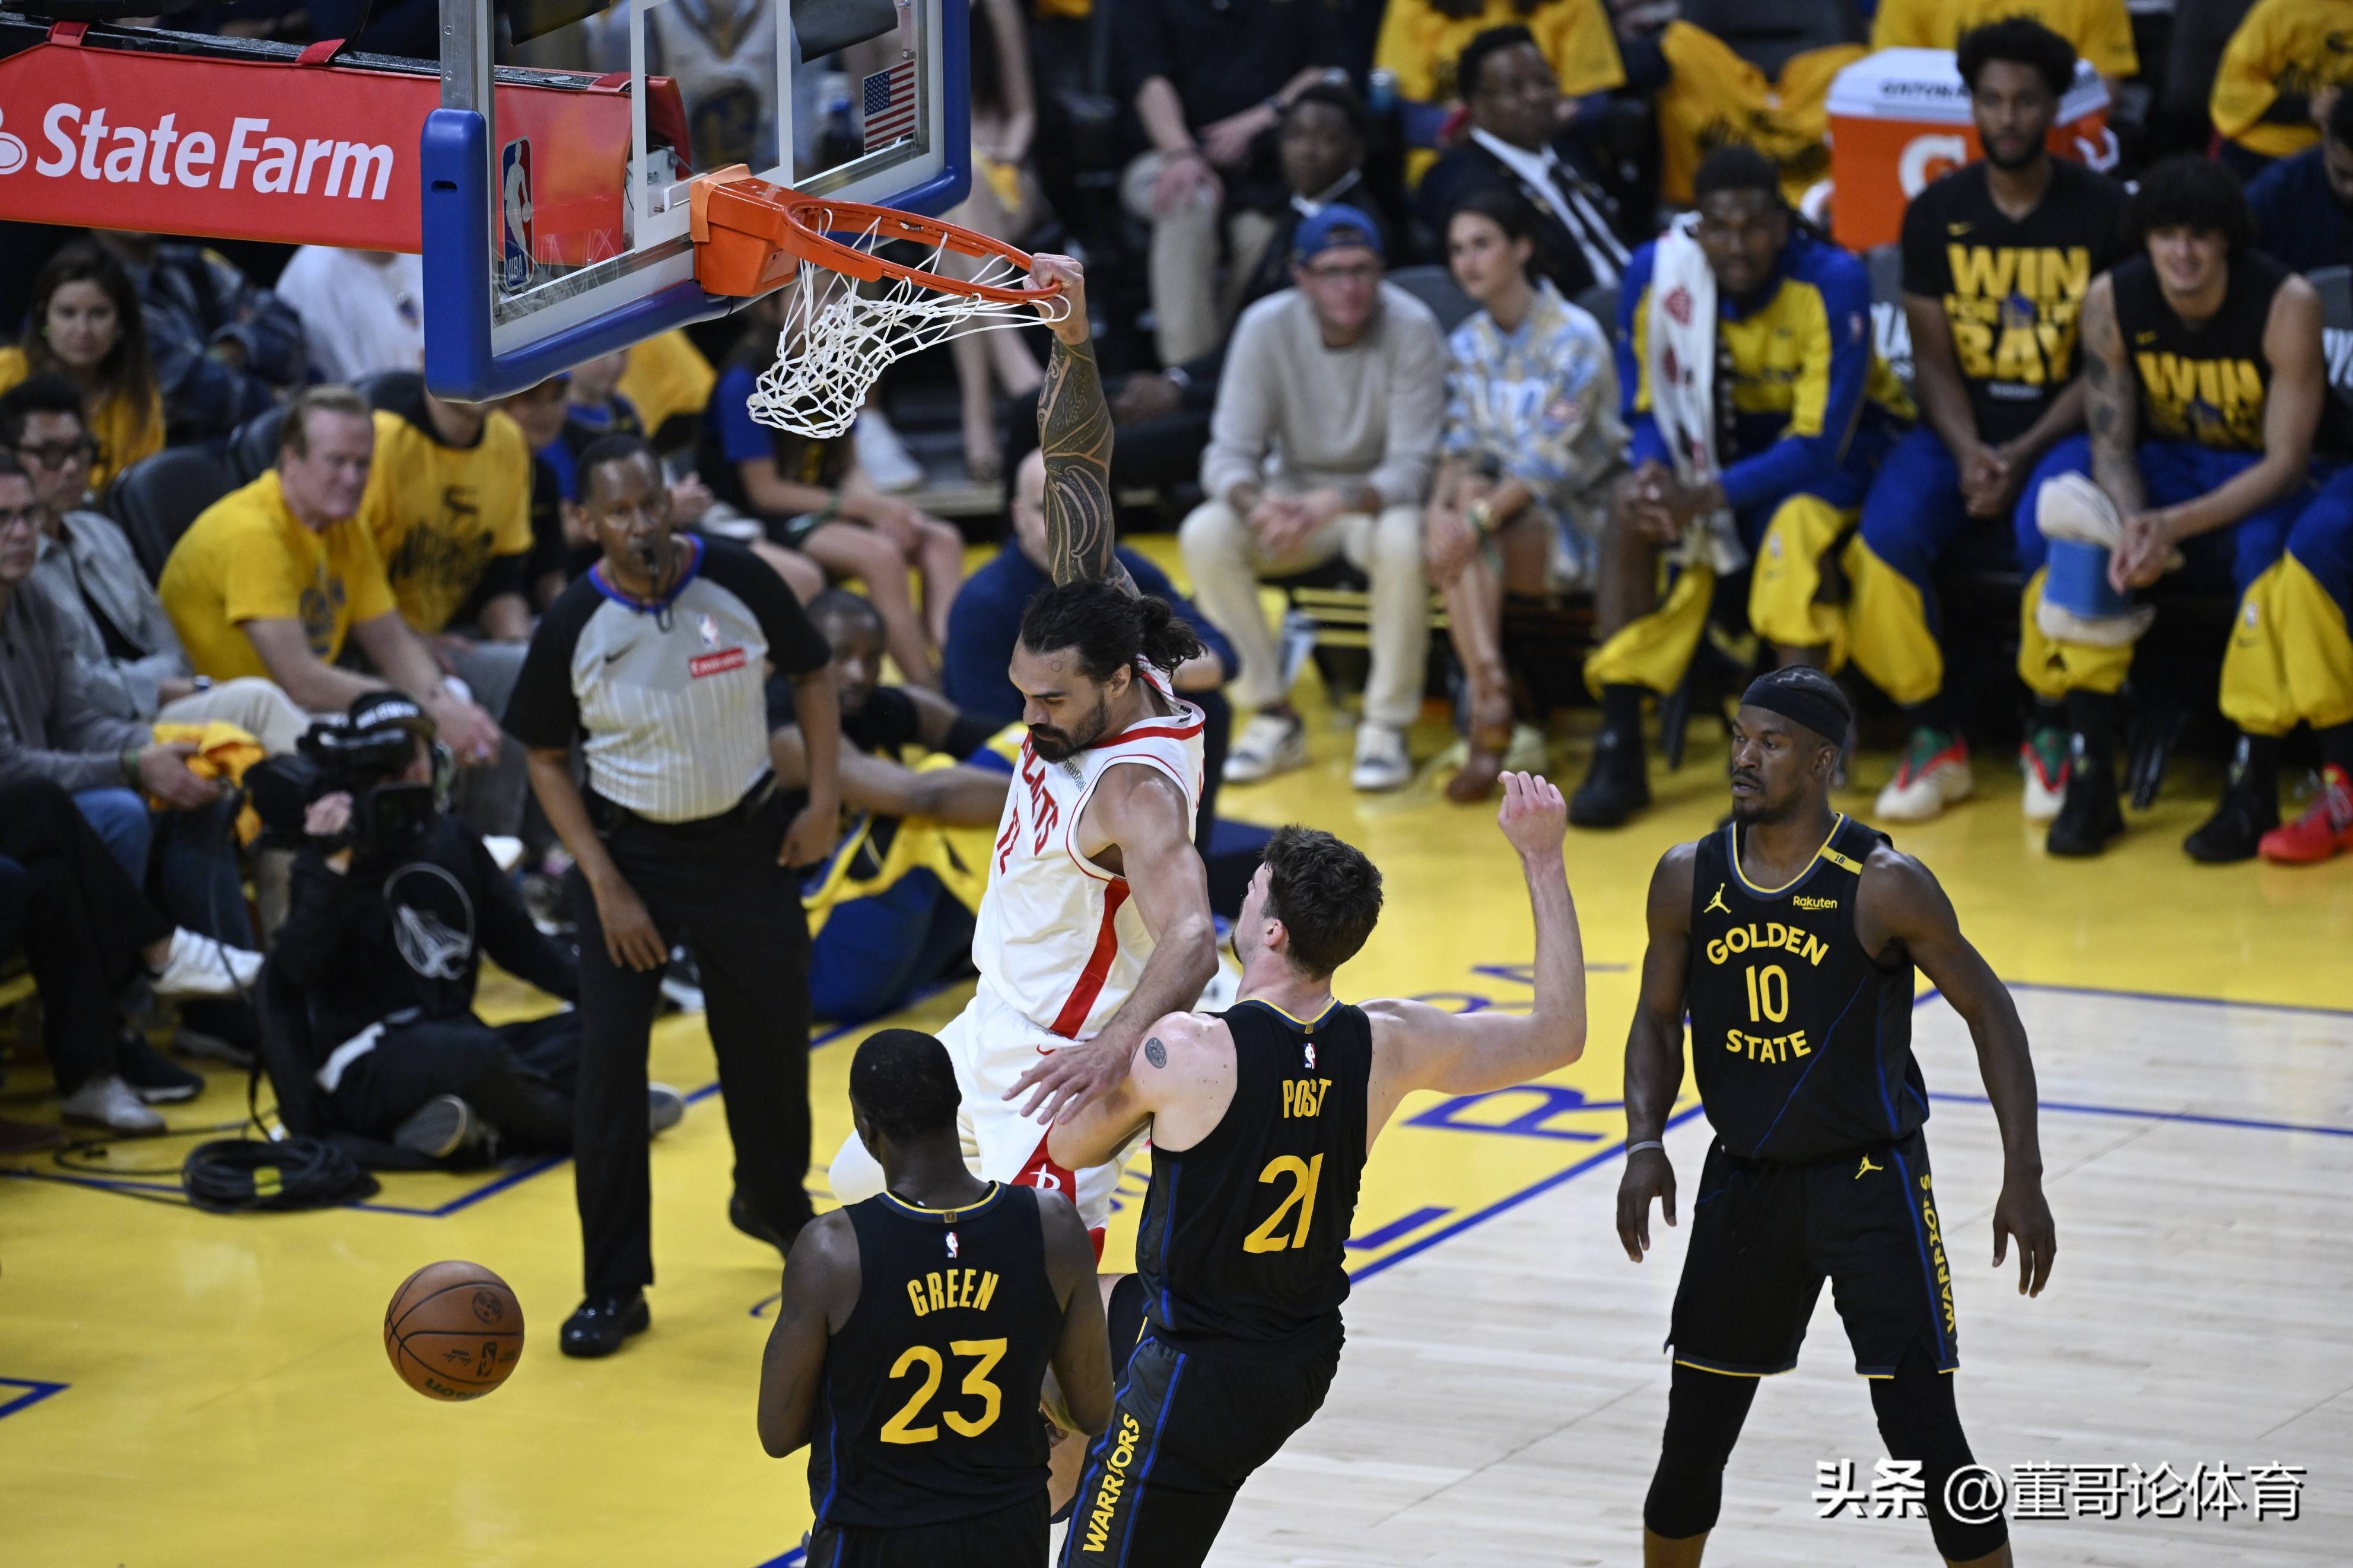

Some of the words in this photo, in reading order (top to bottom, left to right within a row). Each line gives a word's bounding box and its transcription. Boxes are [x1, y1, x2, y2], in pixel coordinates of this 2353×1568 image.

[508, 254, 523, 281] NBA
[1946, 242, 2091, 299] WIN
[1793, 895, 1838, 909] Rakuten
[1706, 923, 1829, 966] GOLDEN
[1745, 965, 1789, 1023] 10
[1726, 1029, 1811, 1064] STATE
[1282, 1078, 1333, 1118] POST
[1243, 1153, 1324, 1254] 21
[907, 1268, 999, 1317] GREEN
[880, 1337, 1007, 1445] 23
[1083, 1413, 1140, 1553] WARRIORS
